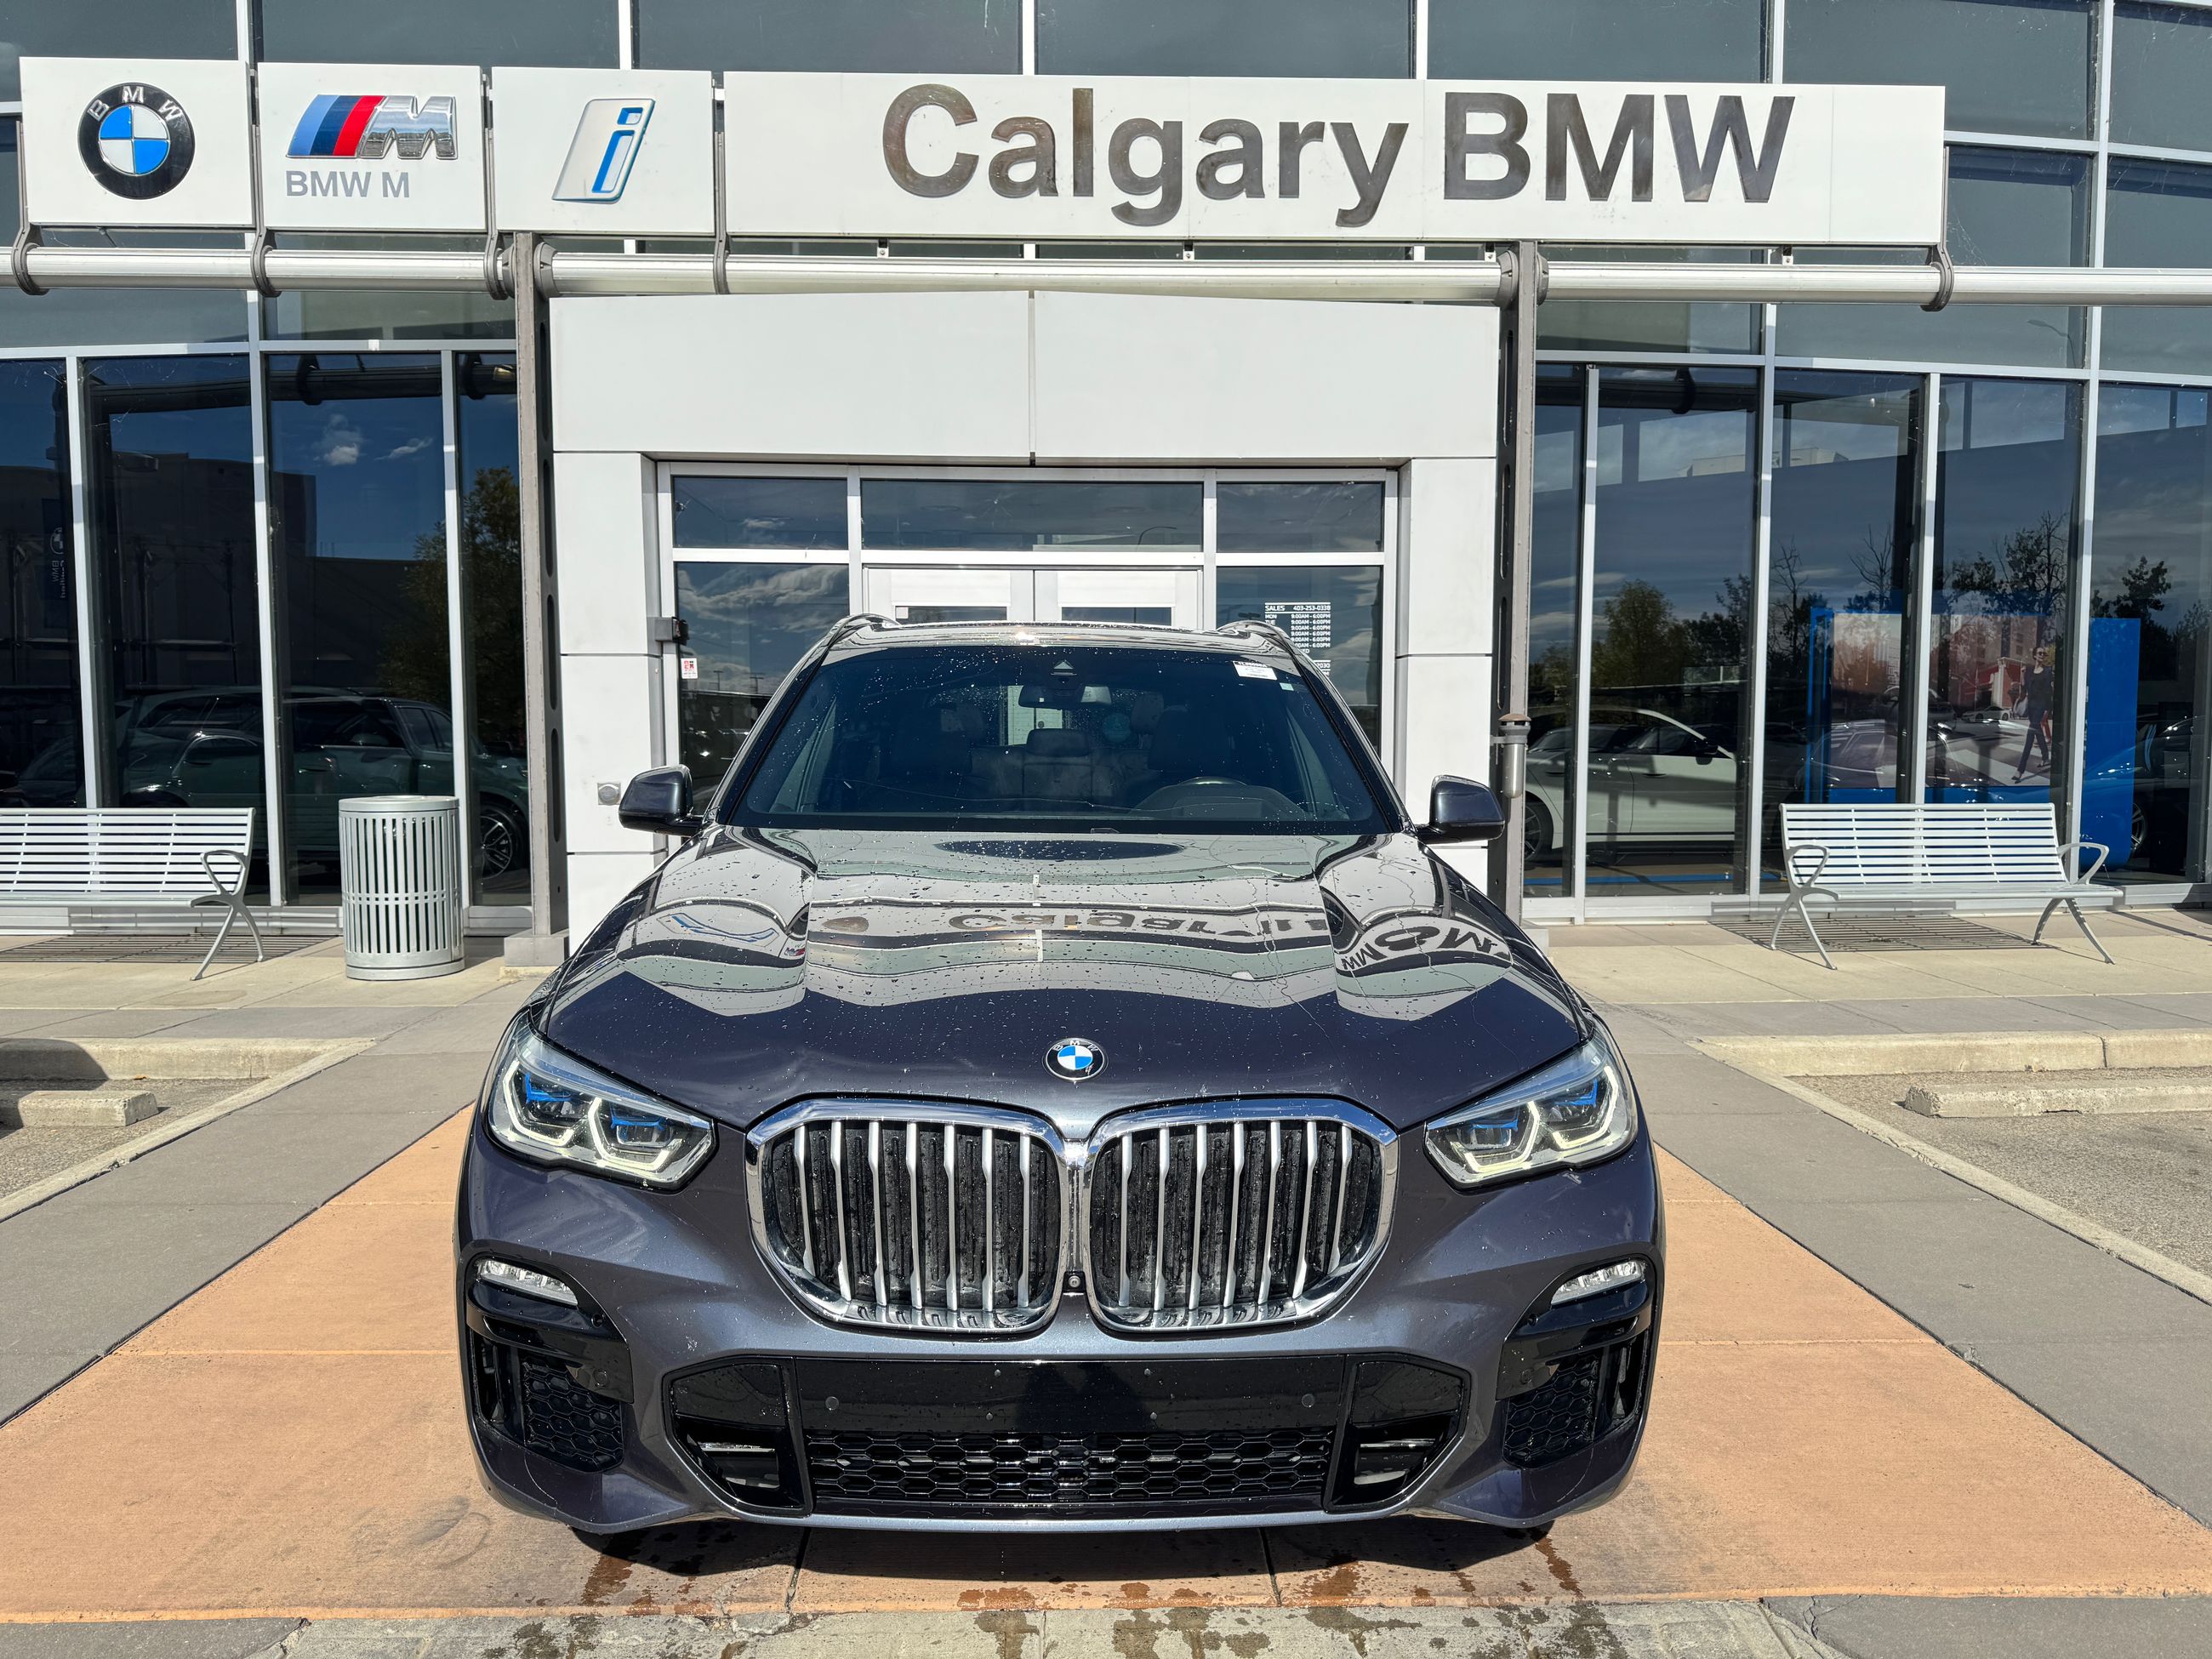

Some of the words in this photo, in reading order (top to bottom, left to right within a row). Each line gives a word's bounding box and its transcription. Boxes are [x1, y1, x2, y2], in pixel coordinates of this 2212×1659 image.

[87, 85, 184, 122] BMW
[882, 83, 1409, 228] Calgary
[1443, 91, 1795, 204] BMW
[286, 170, 371, 197] BMW
[382, 171, 410, 198] M
[1052, 1040, 1099, 1052] BMW
